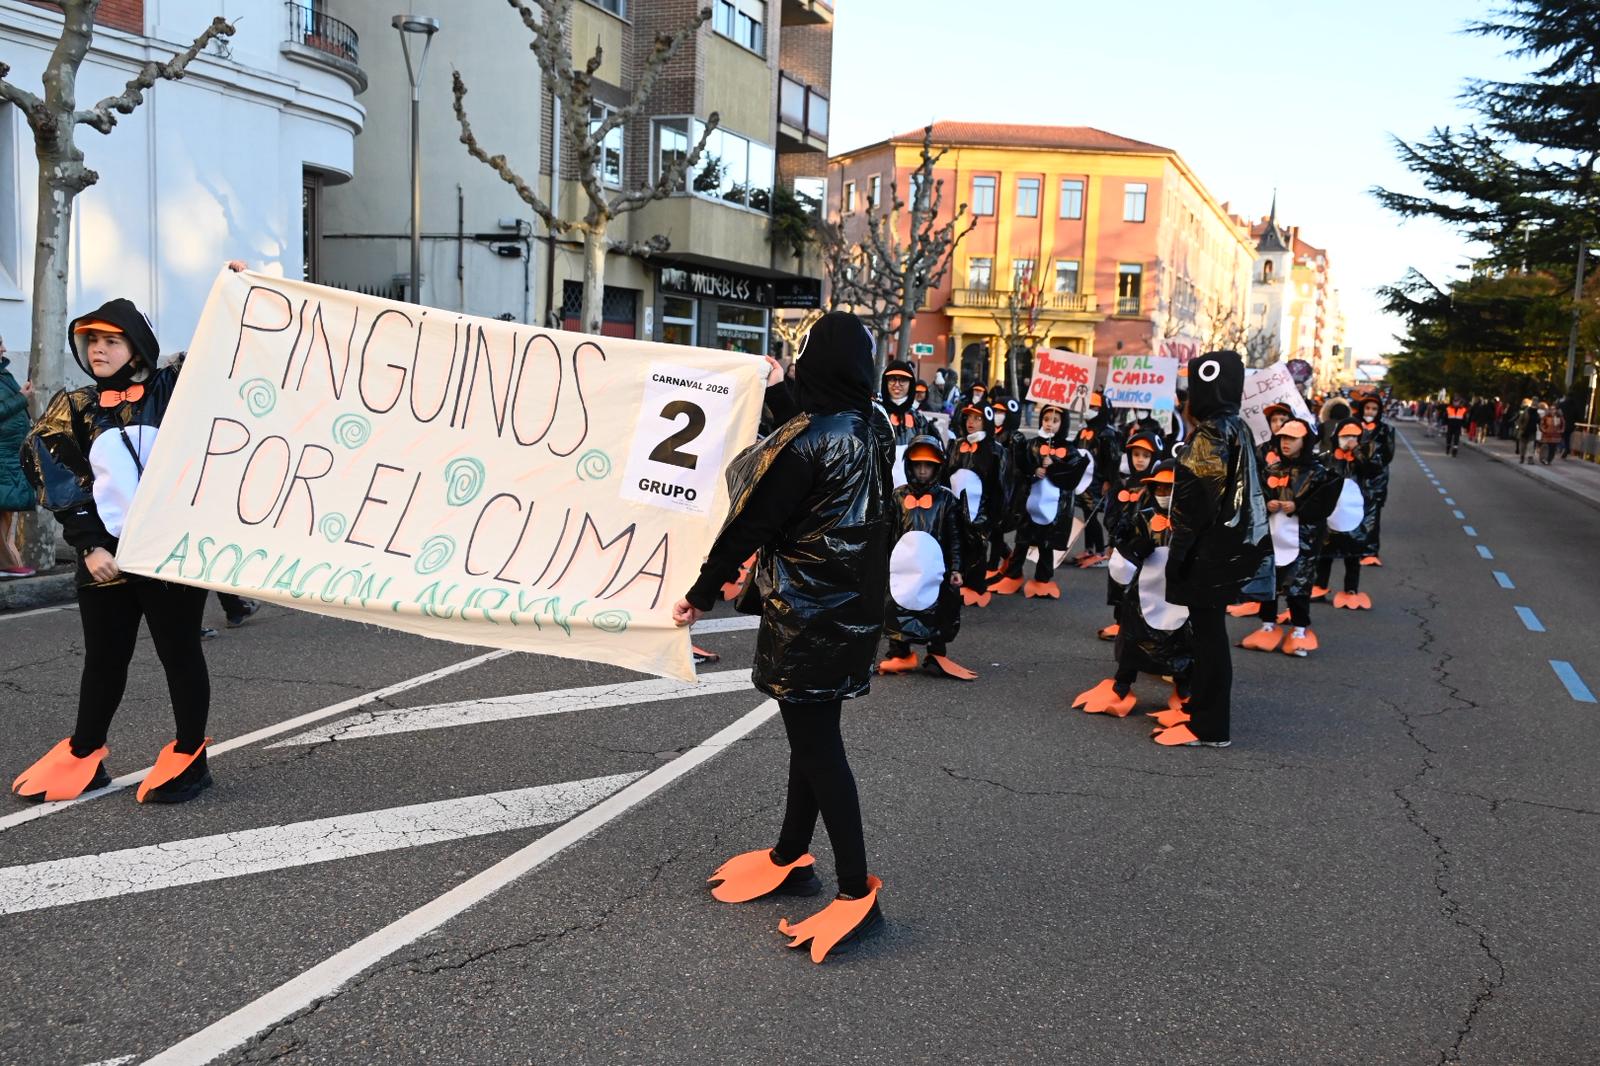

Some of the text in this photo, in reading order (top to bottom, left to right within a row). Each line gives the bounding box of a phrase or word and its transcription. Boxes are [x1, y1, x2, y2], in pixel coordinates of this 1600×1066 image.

[694, 271, 750, 300] MUEBLES
[228, 286, 607, 458] PINGÜINOS
[1037, 352, 1089, 385] TENEMOS
[1112, 356, 1153, 369] NO AL
[652, 373, 729, 395] CARNAVAL 2026
[1031, 377, 1076, 404] CALOR!
[1112, 370, 1165, 385] CAMBIO
[648, 400, 706, 470] 2
[638, 478, 697, 501] GRUPO
[190, 417, 669, 610] POR EL CLIMA
